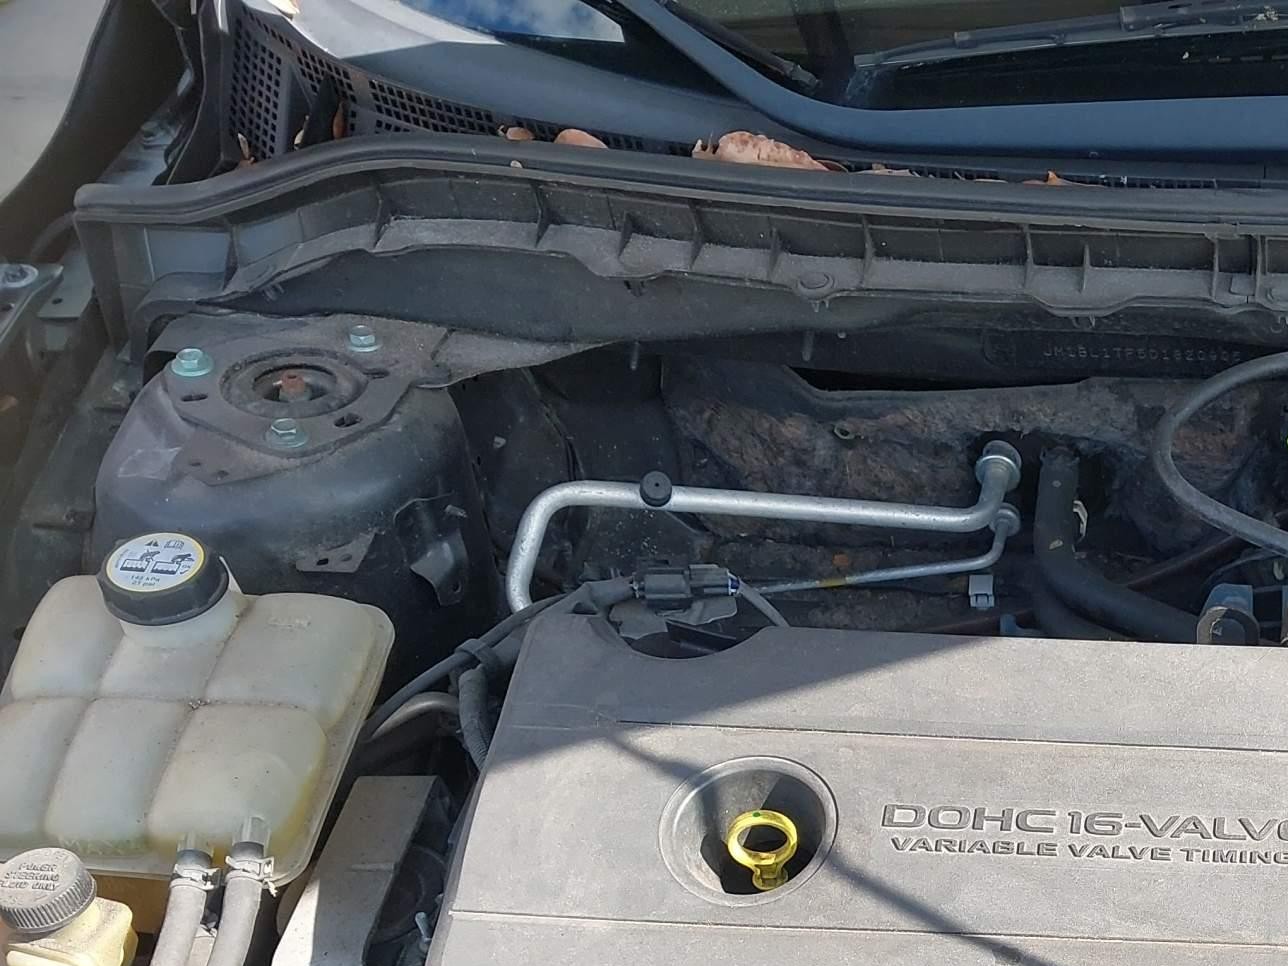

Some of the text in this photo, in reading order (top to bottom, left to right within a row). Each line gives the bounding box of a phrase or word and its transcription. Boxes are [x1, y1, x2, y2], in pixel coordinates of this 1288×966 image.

[881, 804, 1057, 832] DOHC
[891, 837, 1059, 857] VARIABLE
[1068, 844, 1172, 861] VALVE
[19, 862, 57, 872] POWER
[4, 871, 59, 881] STEERING
[32, 882, 59, 891] ONLY
